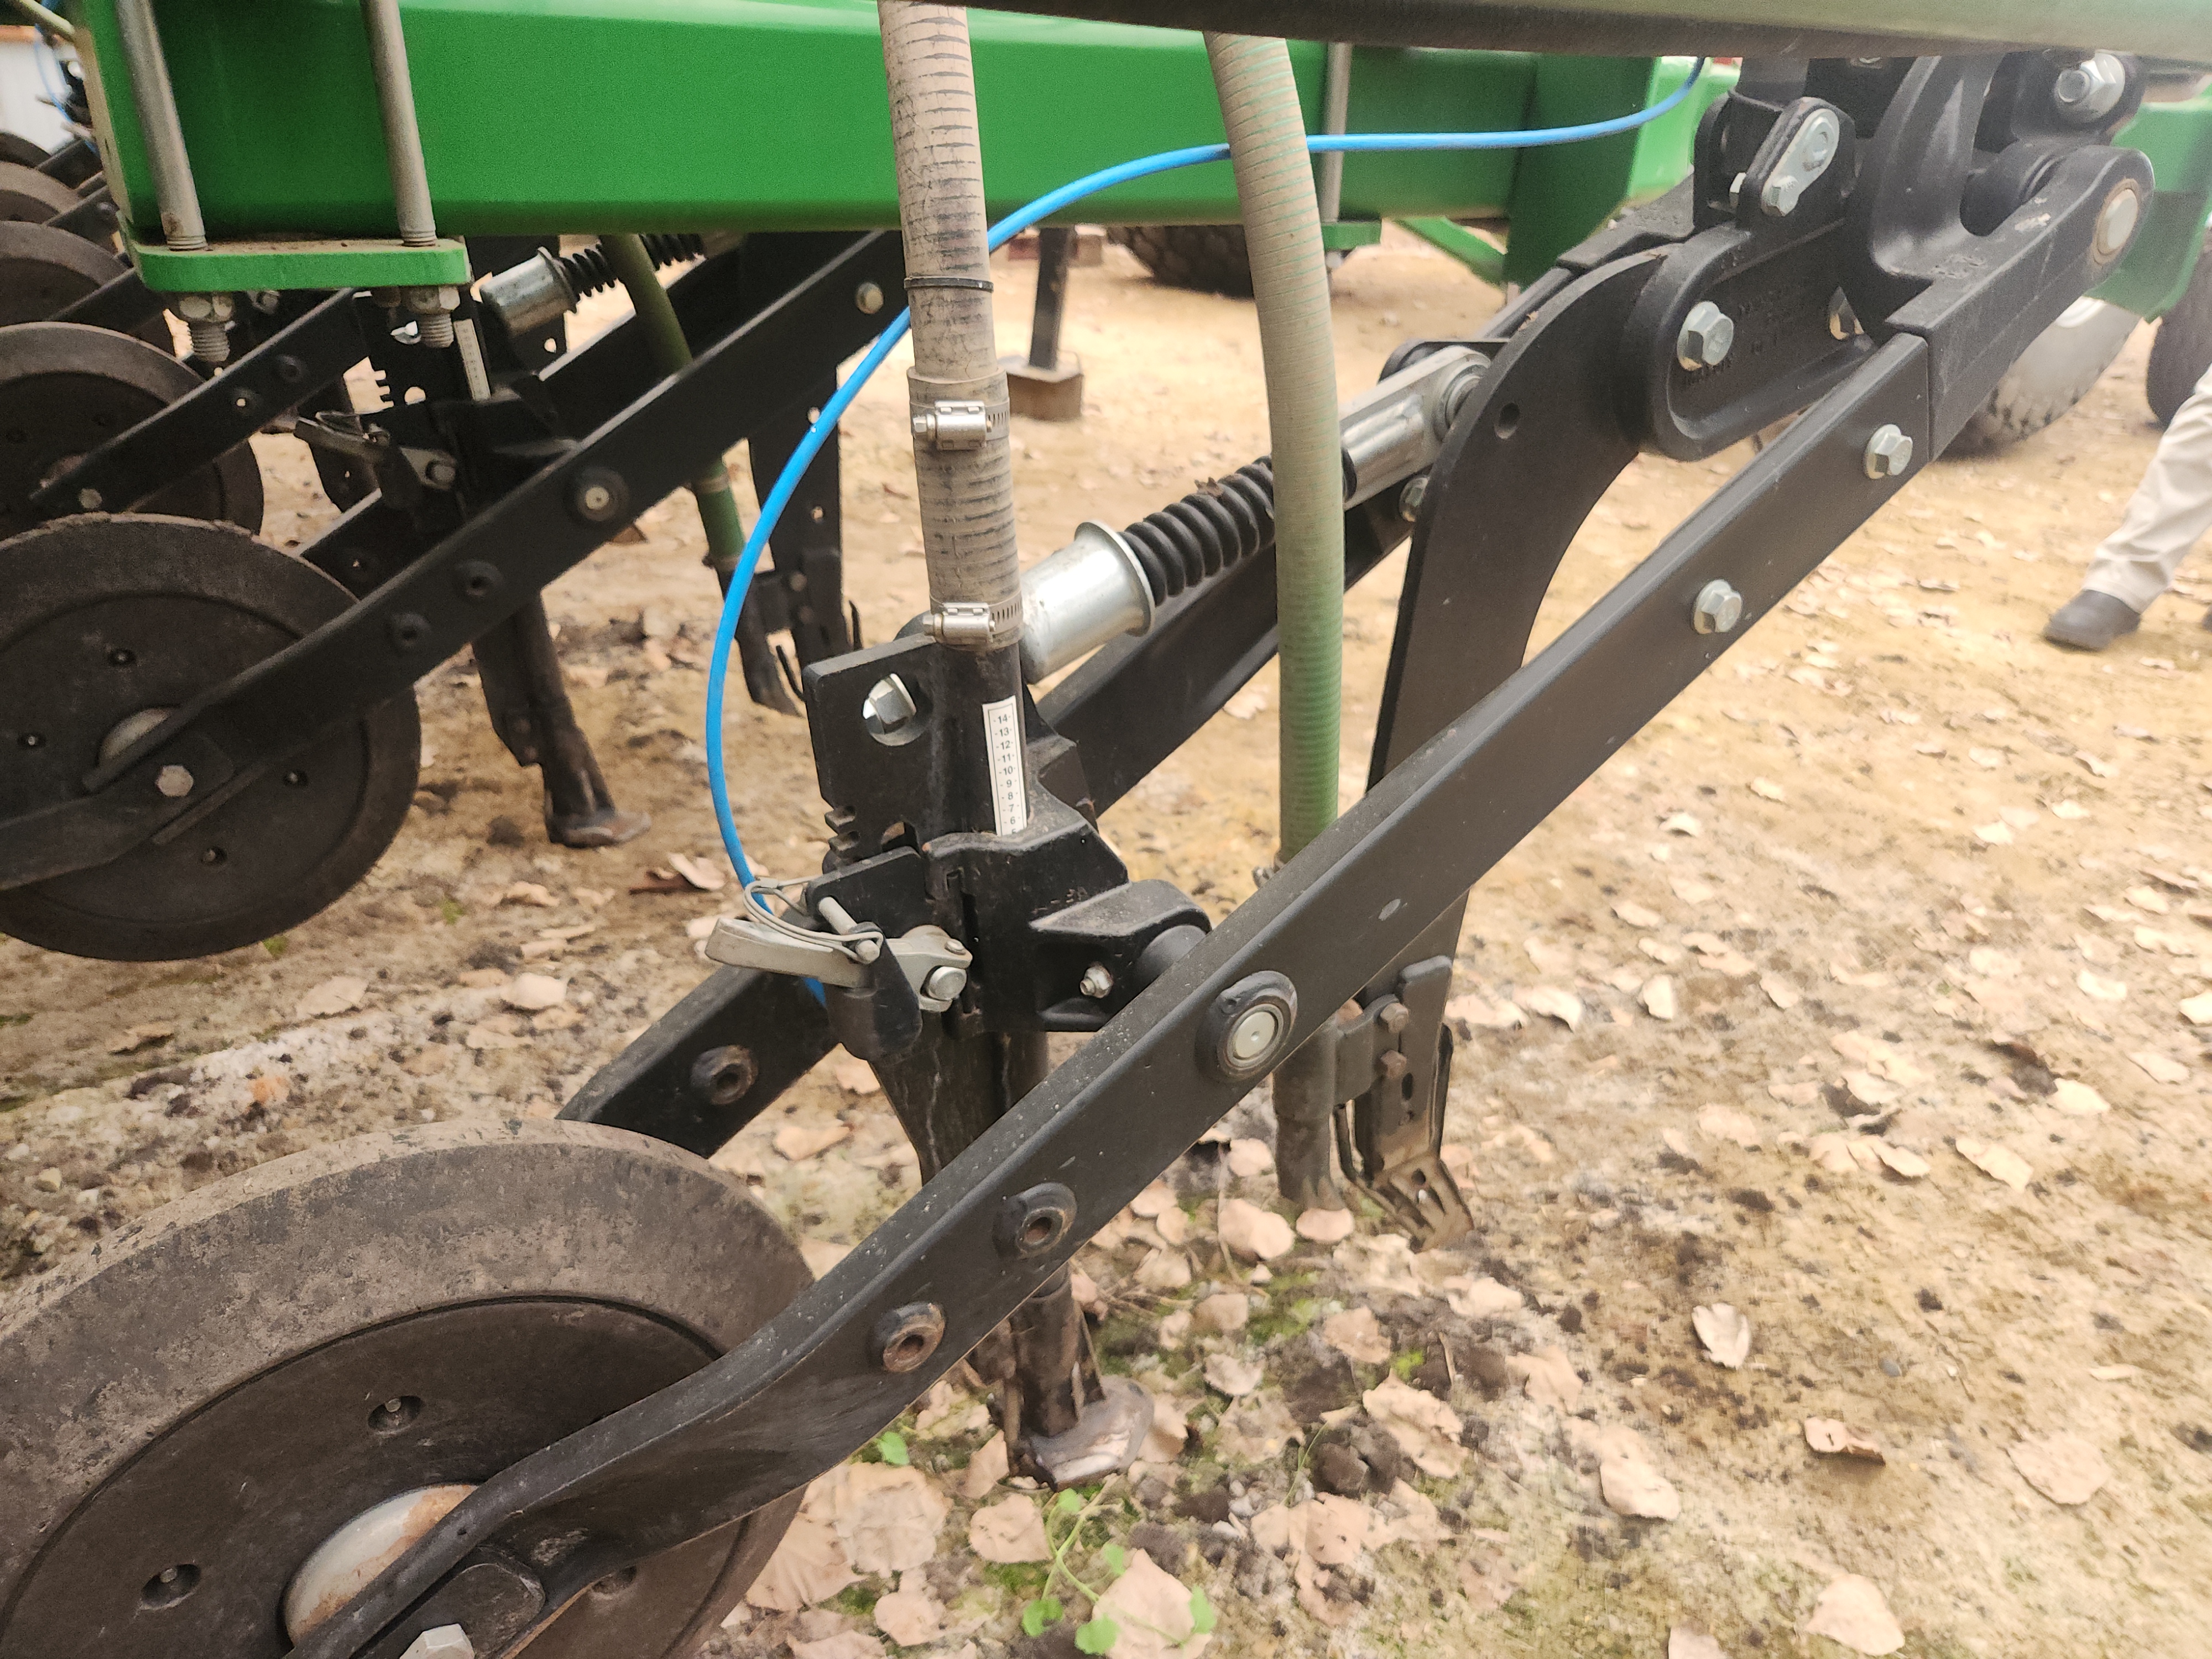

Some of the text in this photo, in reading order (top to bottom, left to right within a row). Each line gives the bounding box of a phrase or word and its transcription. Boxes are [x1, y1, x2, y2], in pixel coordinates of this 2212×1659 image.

[998, 713, 1008, 724] 14
[999, 727, 1009, 737] 13
[1000, 740, 1010, 750] 12
[1001, 753, 1011, 763] 11
[1003, 765, 1013, 775] 10
[1006, 779, 1012, 788] 9
[1008, 791, 1013, 800] 8
[1009, 804, 1014, 812] 7
[1010, 816, 1016, 825] 6
